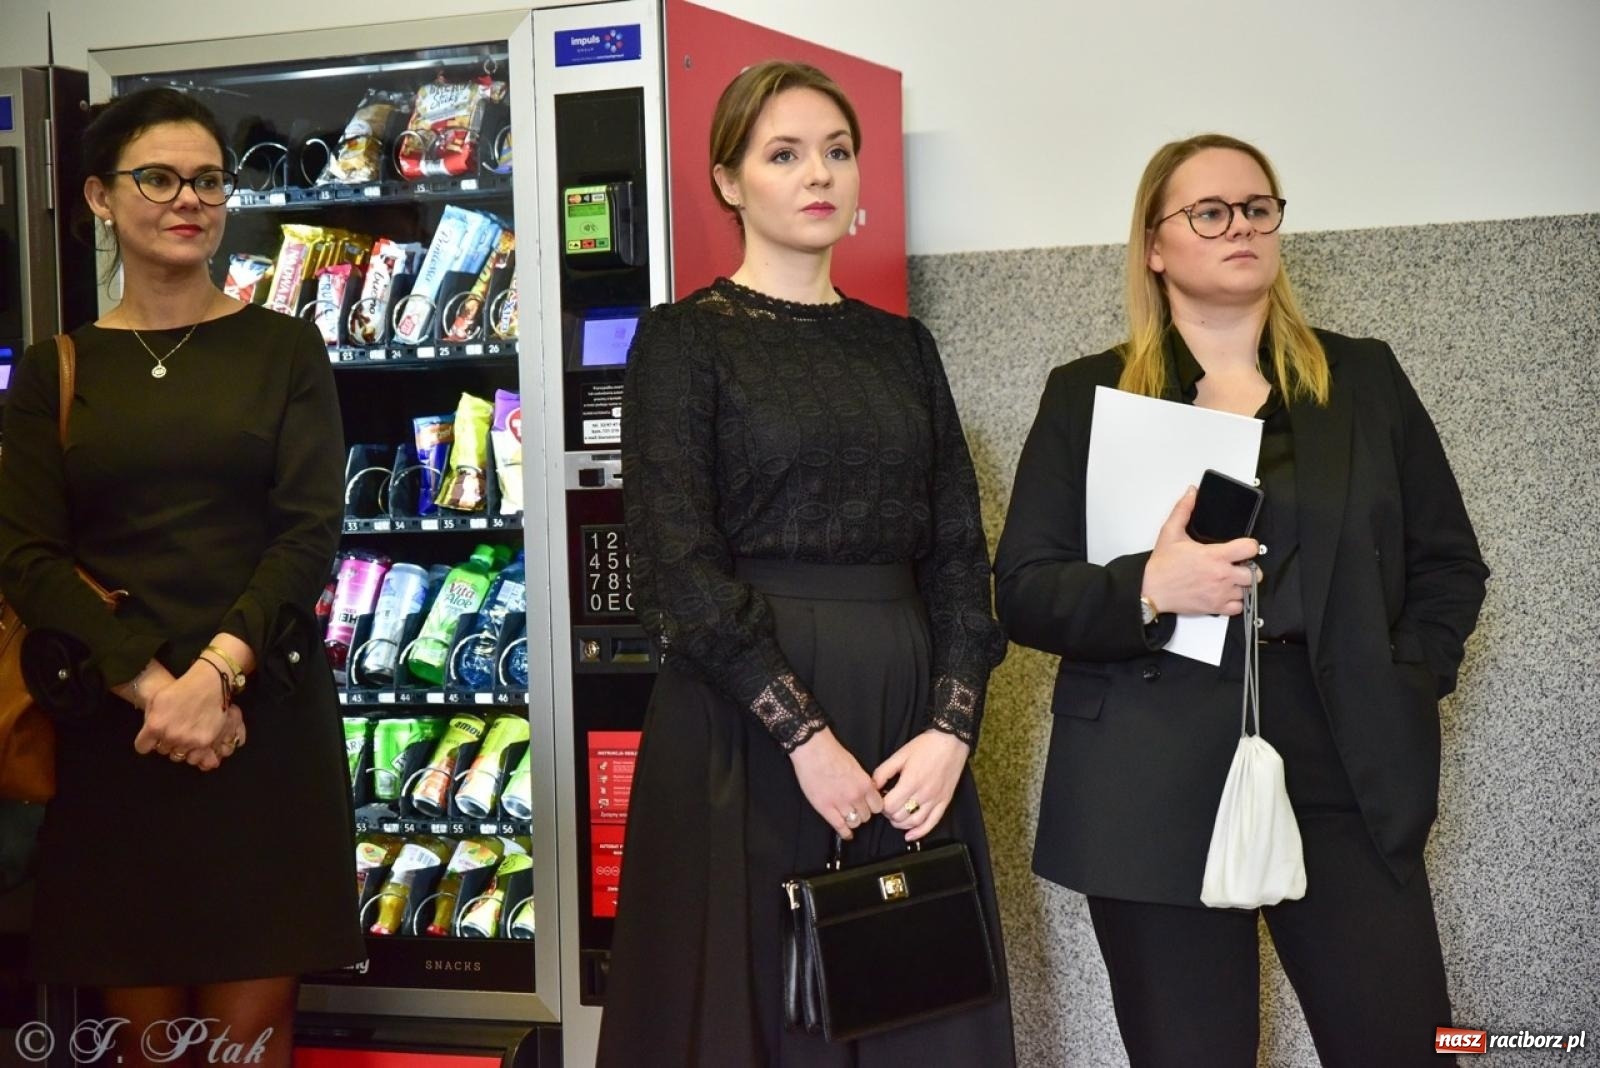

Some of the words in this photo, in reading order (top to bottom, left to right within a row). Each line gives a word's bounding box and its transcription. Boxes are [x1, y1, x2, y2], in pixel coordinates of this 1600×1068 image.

[570, 34, 600, 46] impuls
[439, 346, 450, 356] 25
[488, 344, 500, 354] 26
[347, 521, 358, 531] 33
[394, 520, 406, 530] 34
[443, 519, 455, 529] 35
[492, 518, 504, 528] 36
[590, 532, 599, 550] 1
[606, 532, 618, 550] 2
[589, 552, 601, 570] 4
[607, 552, 619, 570] 5
[589, 573, 601, 591] 7
[608, 573, 620, 590] 8
[449, 581, 475, 599] Vita
[608, 593, 621, 611] E
[400, 693, 411, 702] 44
[448, 693, 460, 703] 45
[497, 693, 509, 703] 46
[355, 822, 367, 833] 53
[404, 823, 415, 833] 54
[453, 823, 464, 834] 55
[502, 824, 514, 834] 56
[425, 960, 481, 971] SNACKS
